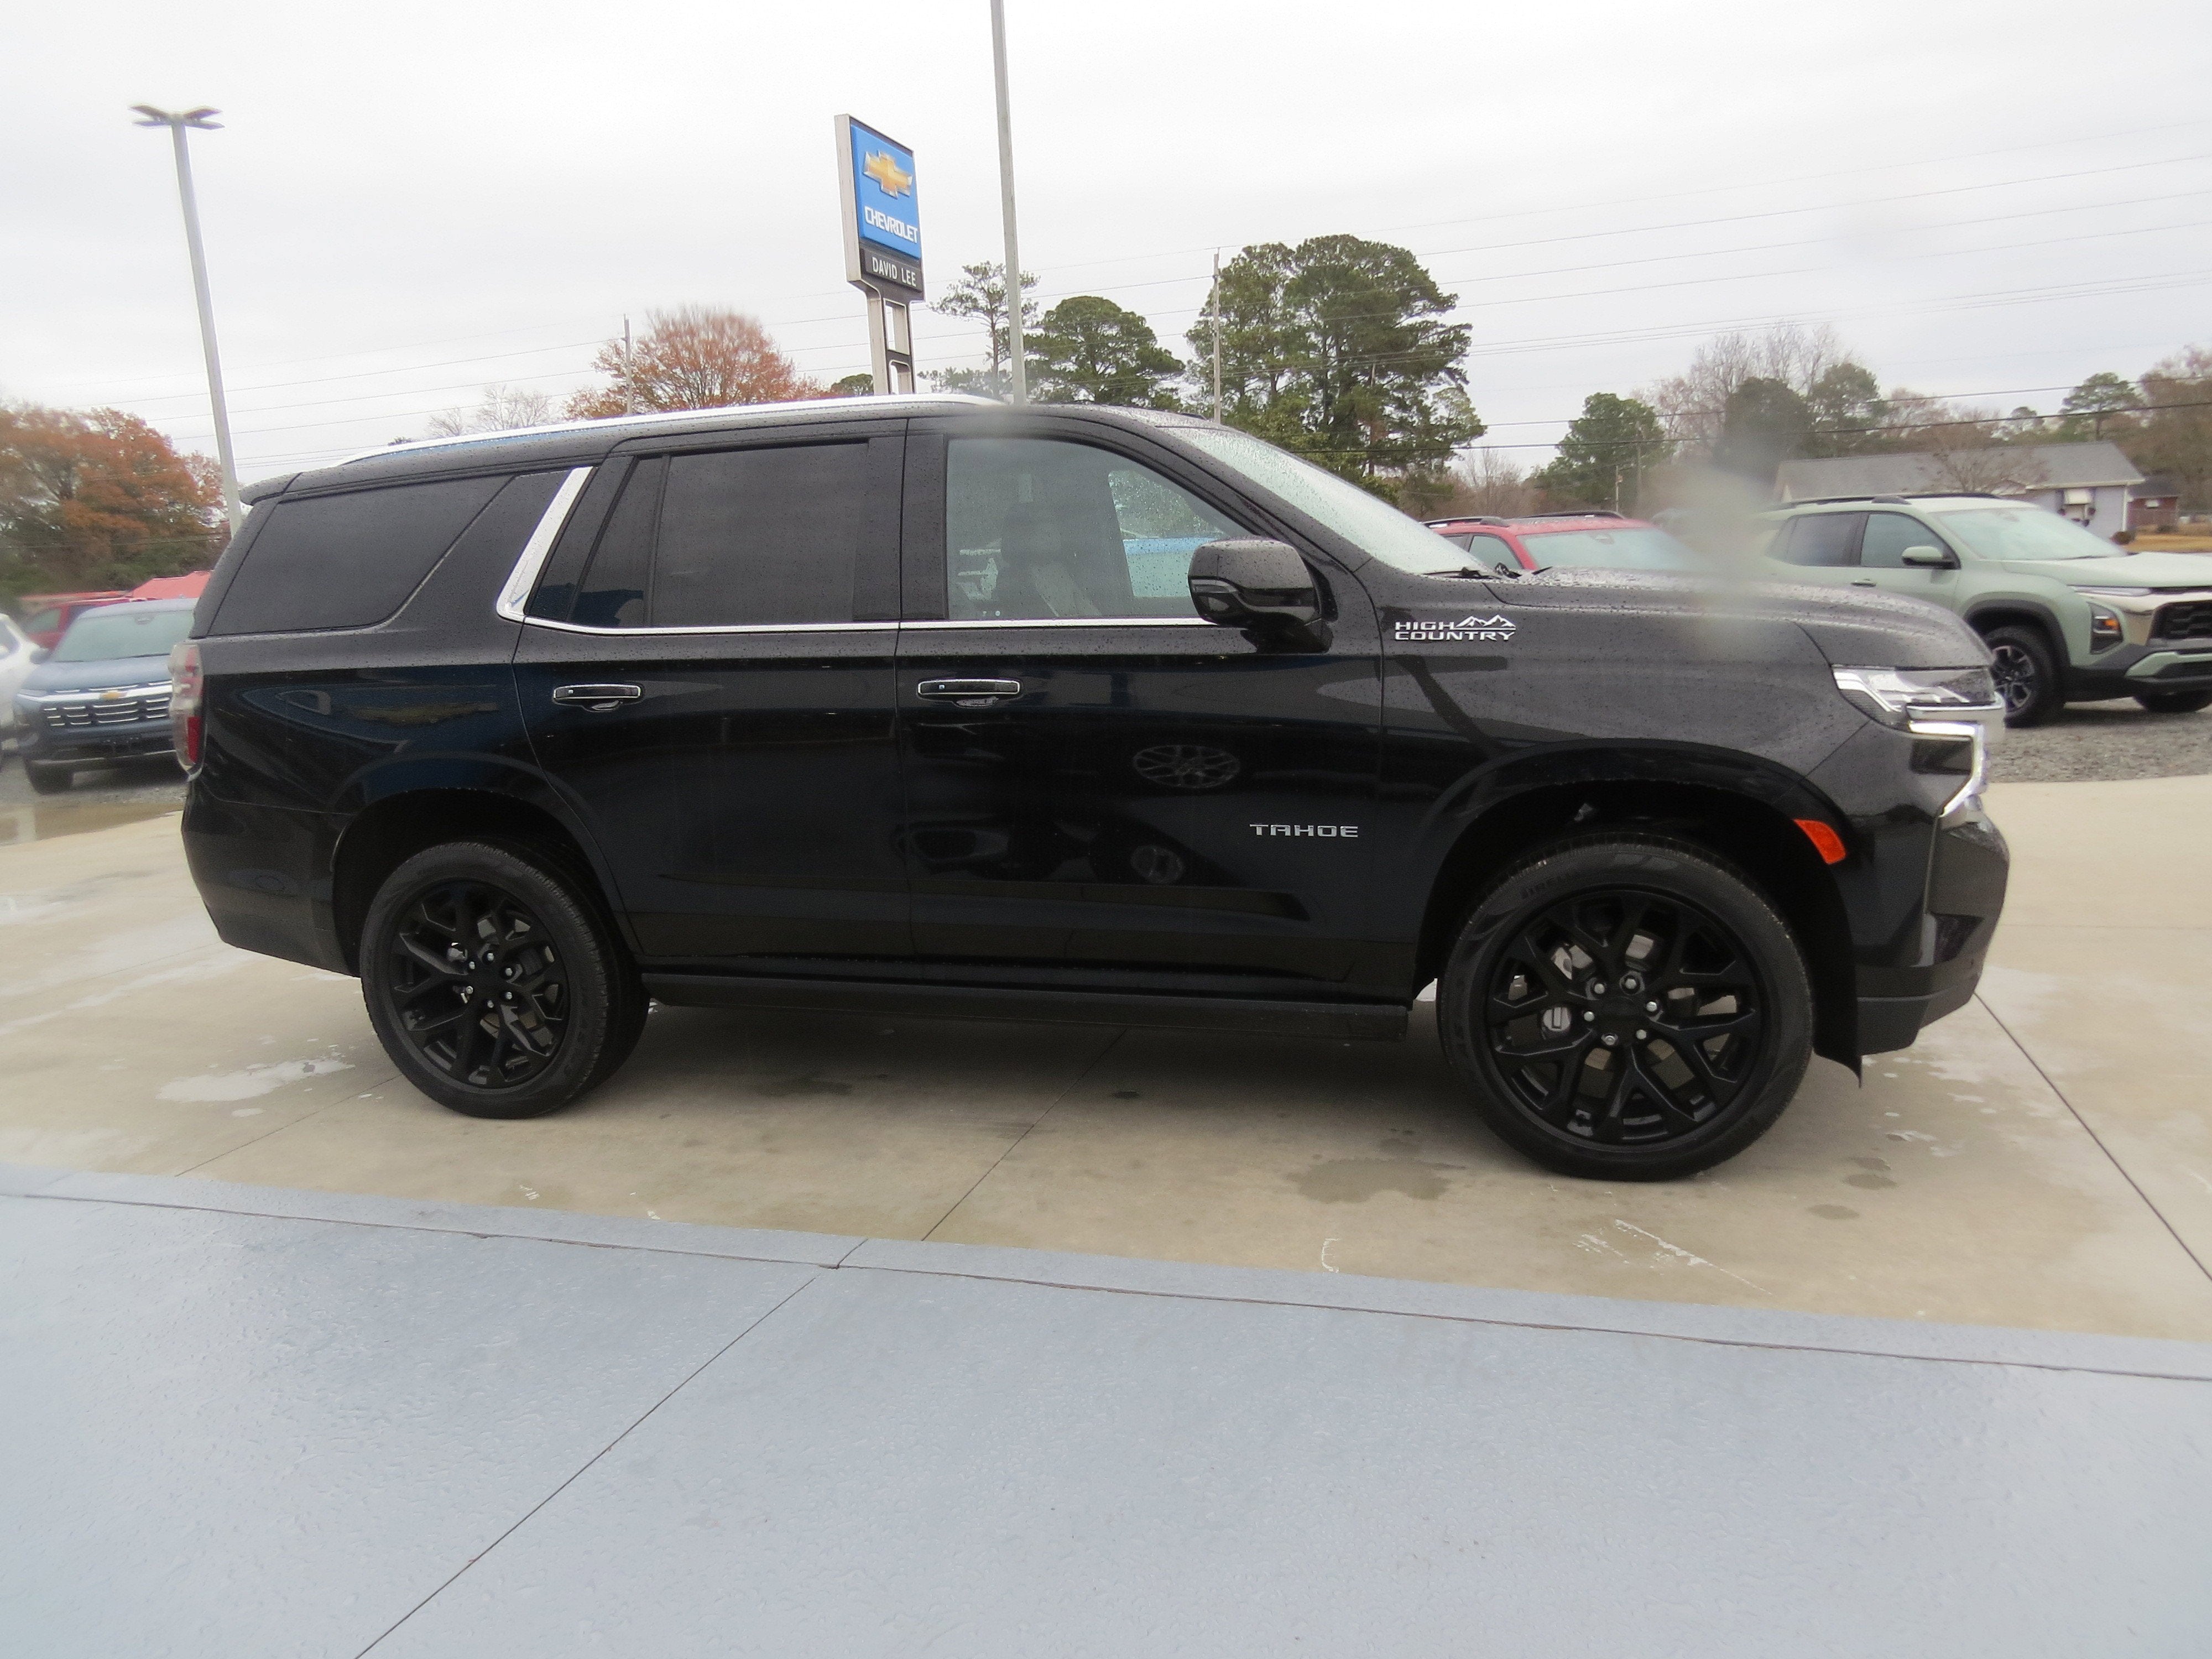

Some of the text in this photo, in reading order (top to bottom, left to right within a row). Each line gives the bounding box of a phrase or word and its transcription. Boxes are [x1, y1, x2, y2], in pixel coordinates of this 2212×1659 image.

[865, 206, 917, 243] CHEVROLET
[872, 257, 917, 287] DAVID LEE
[1395, 622, 1454, 630] HIGH
[1395, 632, 1515, 640] COUNTRY
[1249, 824, 1358, 837] TAHOE
